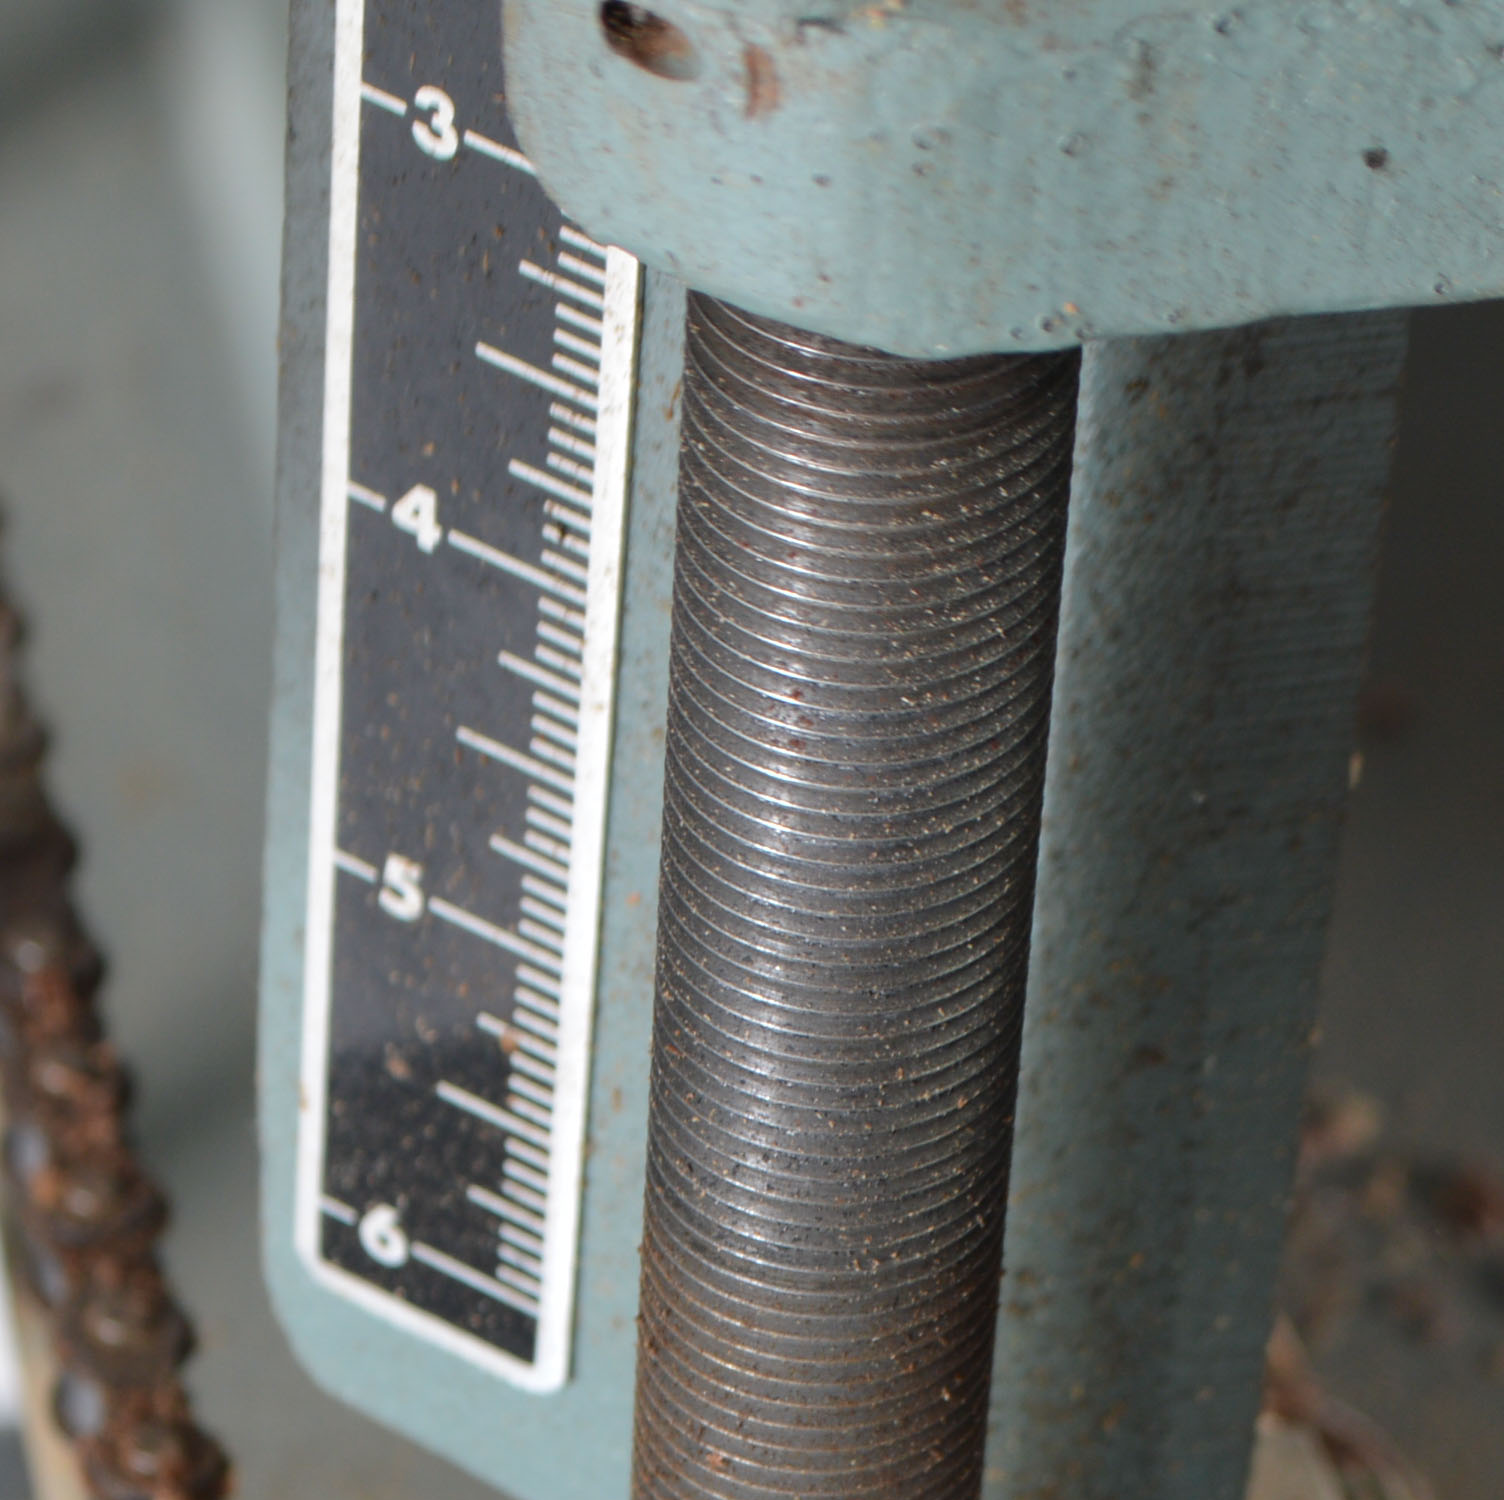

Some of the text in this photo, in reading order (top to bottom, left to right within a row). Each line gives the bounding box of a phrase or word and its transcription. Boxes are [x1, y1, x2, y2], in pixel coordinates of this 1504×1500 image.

[412, 85, 458, 160] 3
[392, 484, 442, 554] 4
[378, 853, 424, 921] 5
[359, 1205, 409, 1267] 6
